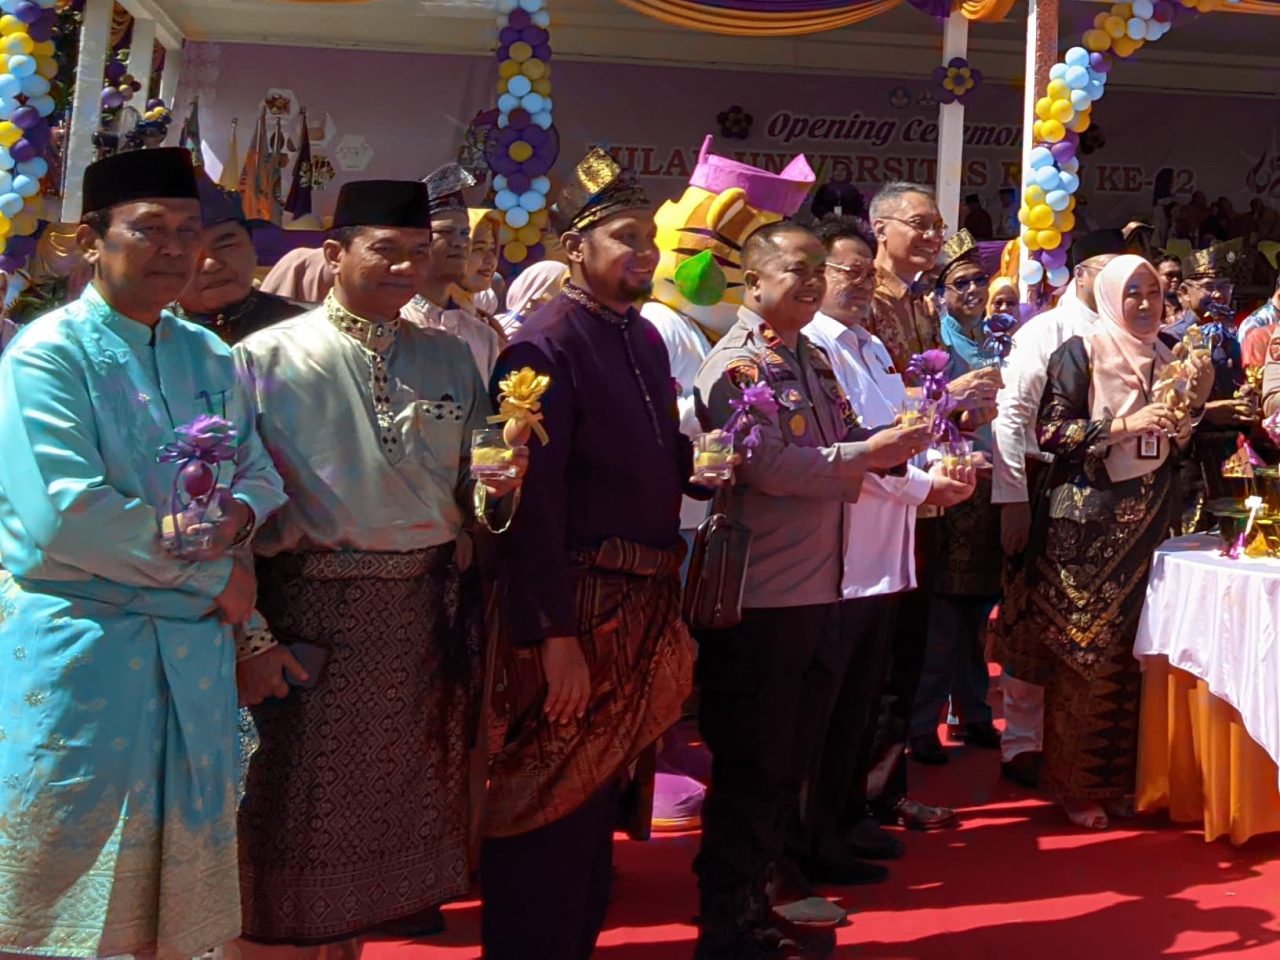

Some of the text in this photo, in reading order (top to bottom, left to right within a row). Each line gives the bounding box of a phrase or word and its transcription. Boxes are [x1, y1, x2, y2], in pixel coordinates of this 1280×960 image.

[767, 112, 897, 147] Opening
[588, 145, 705, 177] ILA
[1096, 165, 1195, 193] KE-2
